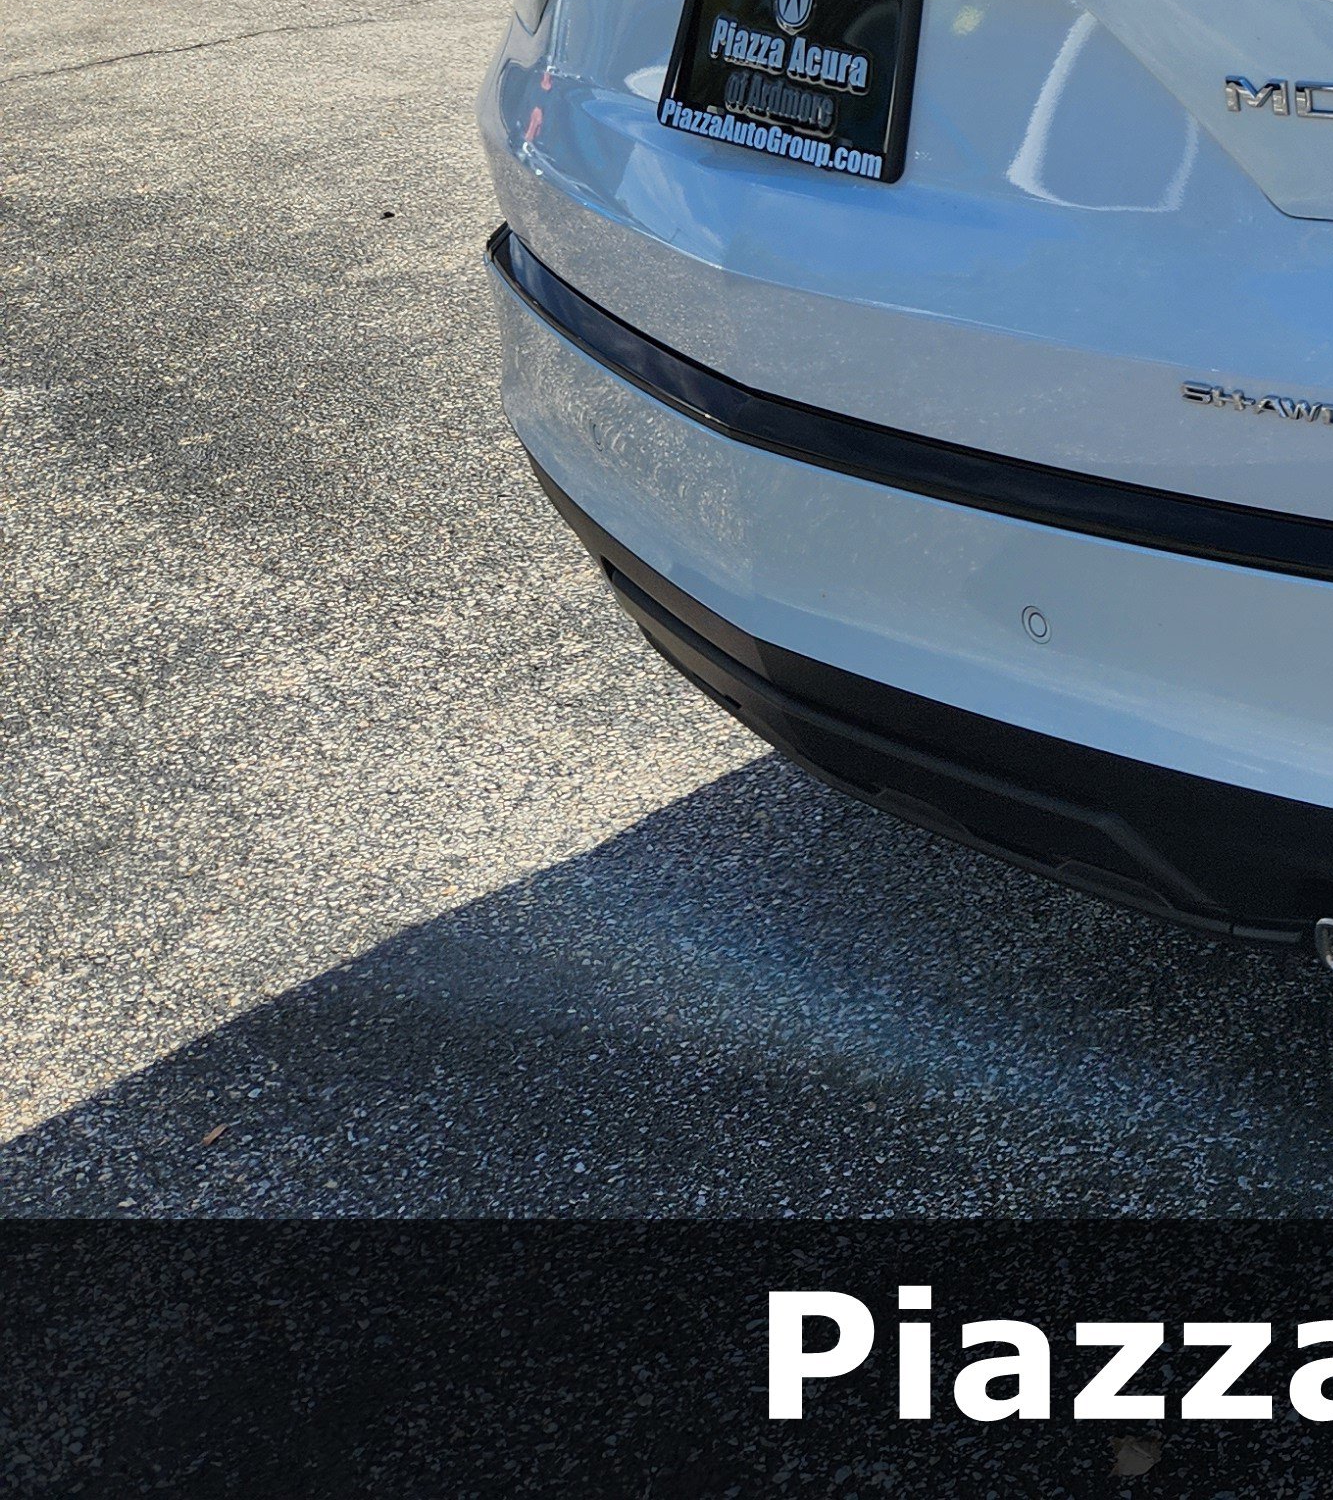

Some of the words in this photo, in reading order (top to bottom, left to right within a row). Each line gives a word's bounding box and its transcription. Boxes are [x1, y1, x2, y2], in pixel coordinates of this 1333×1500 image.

[711, 17, 785, 75] Piazza
[787, 36, 869, 89] Acura
[724, 70, 746, 107] of
[747, 76, 835, 130] Ardmore
[660, 98, 883, 179] PiazzaAutoGroup.com
